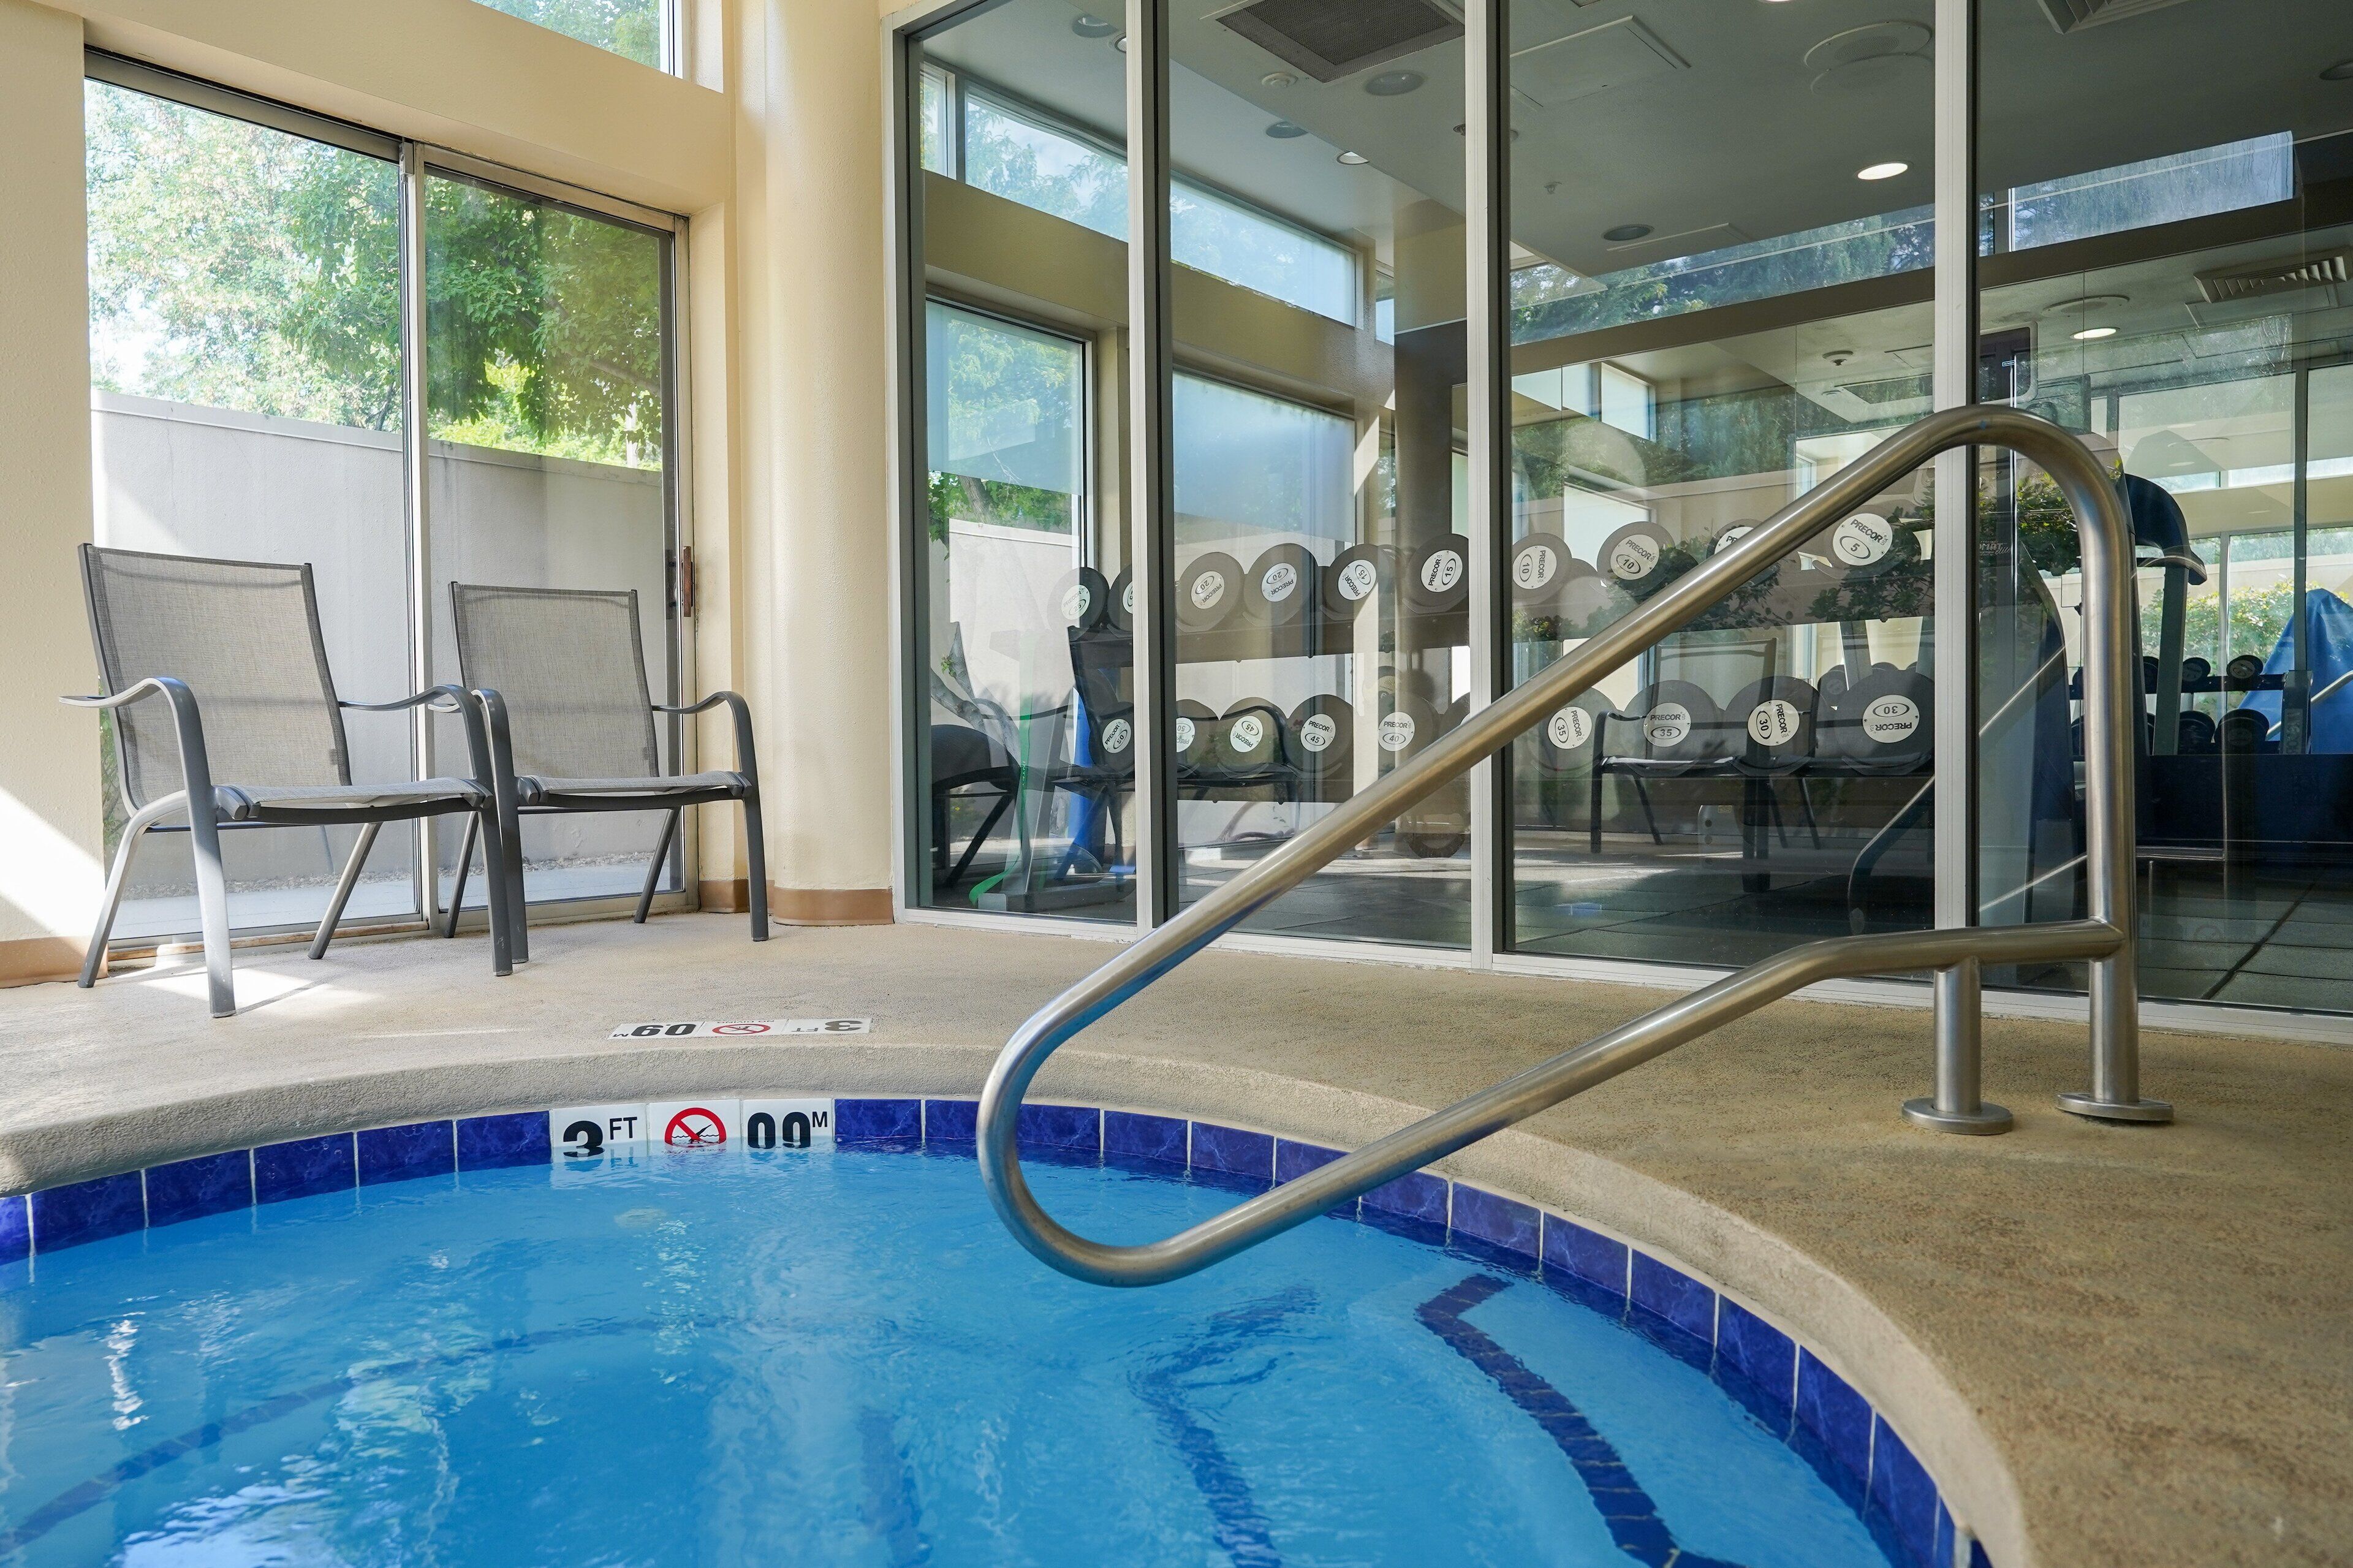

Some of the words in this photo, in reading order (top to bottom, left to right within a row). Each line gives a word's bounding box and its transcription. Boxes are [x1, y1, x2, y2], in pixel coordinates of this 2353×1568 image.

[1849, 518, 1883, 543] PRECOR
[1625, 539, 1652, 562] PRECOR
[1851, 543, 1860, 552] 5
[1521, 562, 1529, 574] 10
[1537, 550, 1546, 579] PRECOR
[1622, 558, 1635, 569] 10
[1273, 571, 1282, 581] 20
[1358, 569, 1368, 580] 15
[1428, 558, 1442, 586] PRECOR
[1444, 566, 1453, 577] 15
[1200, 580, 1210, 590] 20
[1271, 579, 1294, 595] PRECOR
[1344, 575, 1361, 597] PRECOR
[1202, 583, 1222, 603] PRECOR
[1884, 705, 1898, 714] 30
[1571, 710, 1583, 738] PRECOR
[1759, 718, 1769, 731] 30
[1775, 703, 1788, 734] PRECOR
[1308, 720, 1330, 732] PRECOR
[1557, 724, 1566, 736] 35
[1875, 722, 1912, 731] PRECOR
[1105, 724, 1121, 745] PRECOR
[1116, 735, 1124, 744] 50
[1235, 732, 1254, 748] PRECOR
[824, 1020, 863, 1031] 3
[812, 1111, 828, 1128] M
[563, 1120, 605, 1157] 3
[610, 1116, 637, 1140] FT
